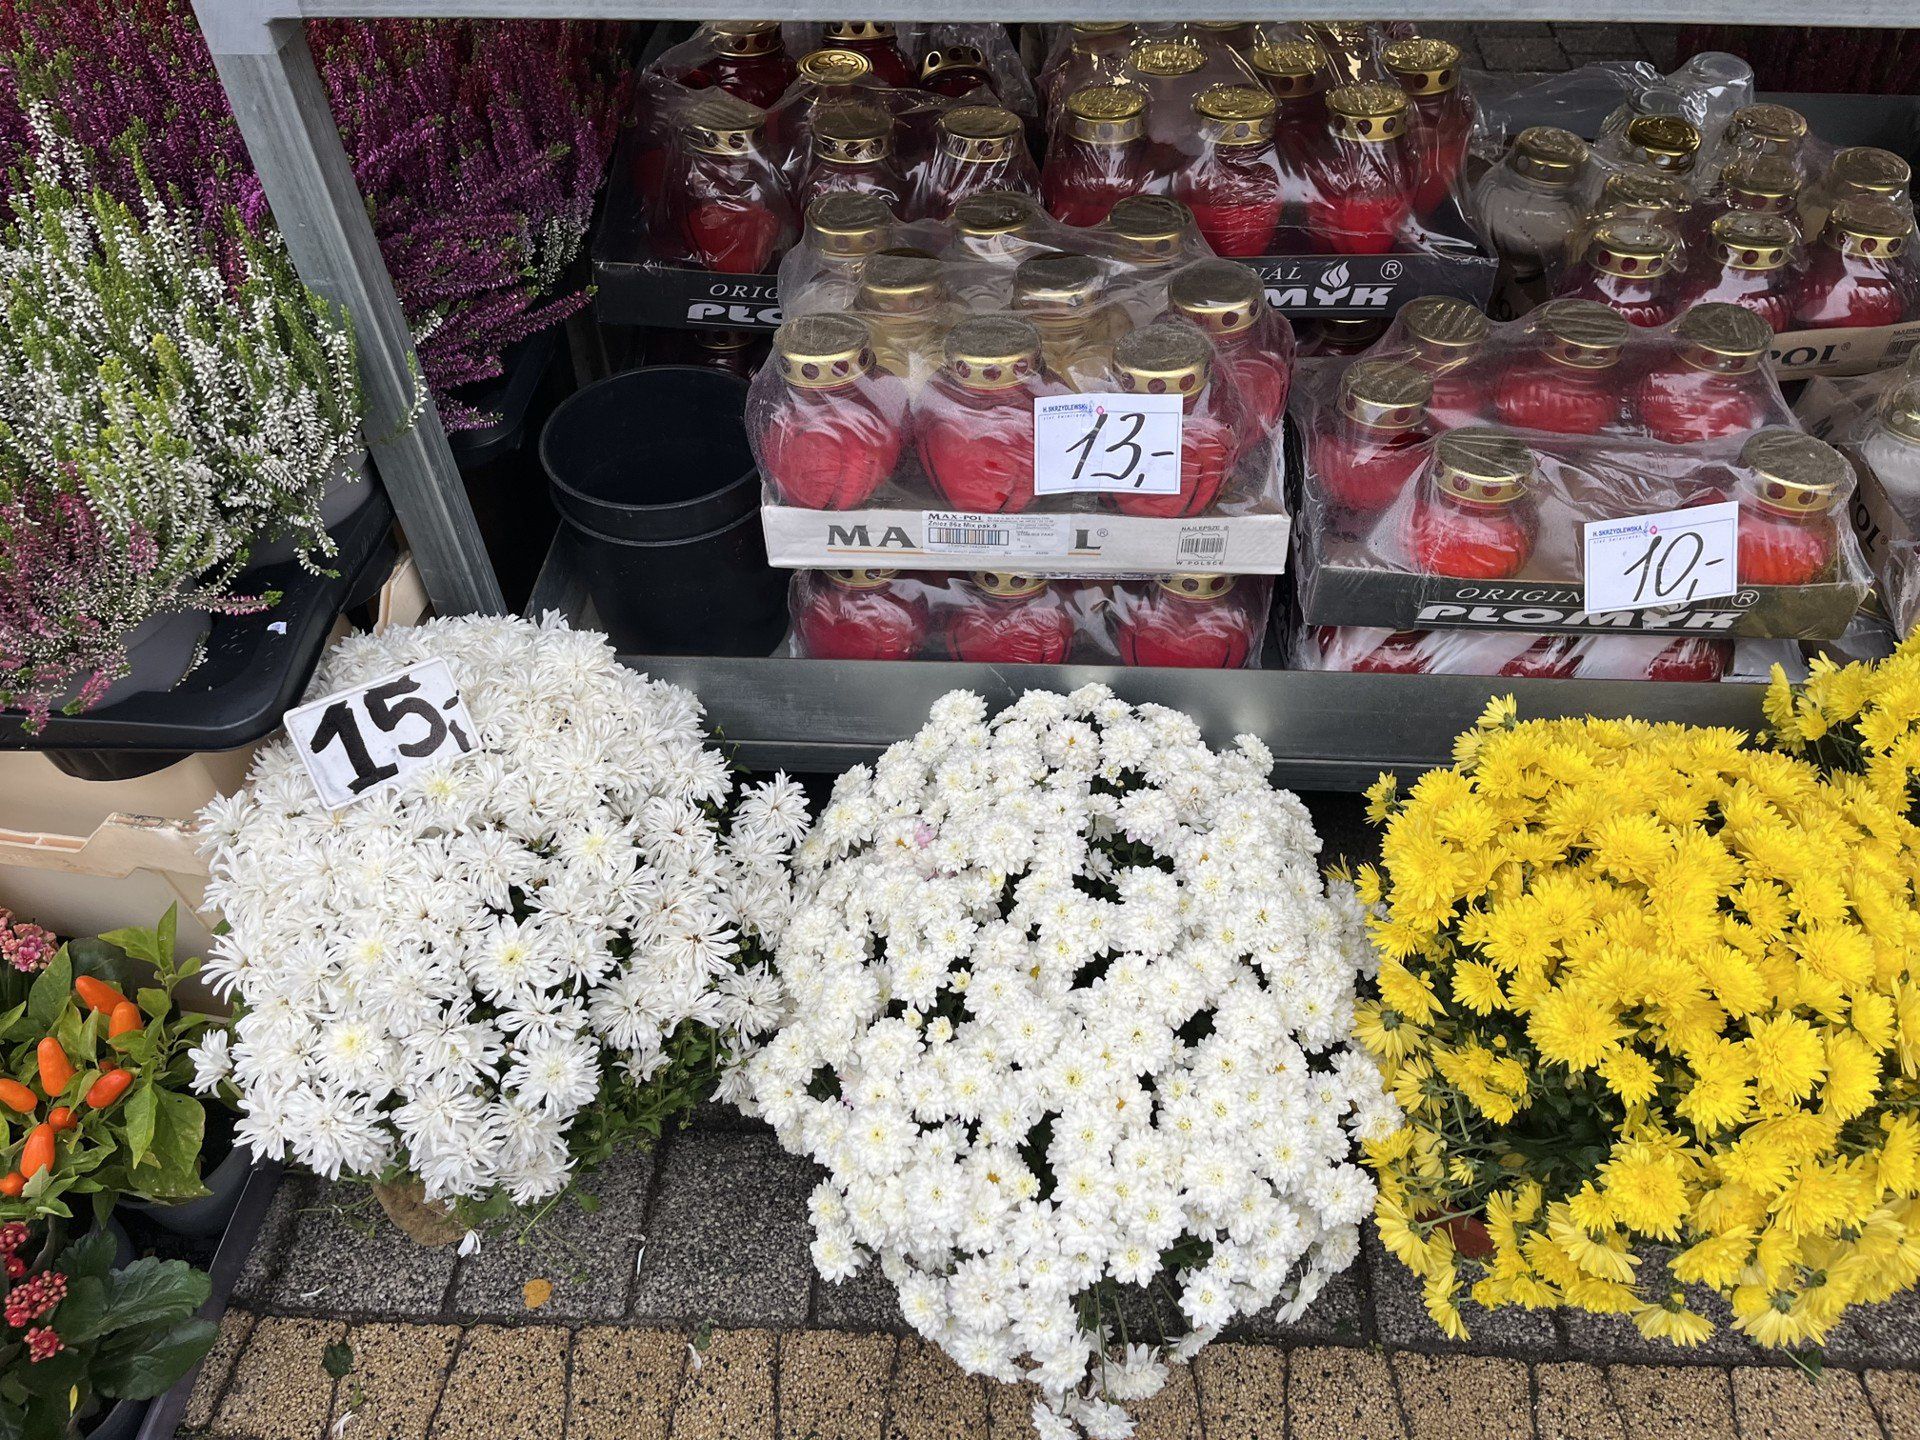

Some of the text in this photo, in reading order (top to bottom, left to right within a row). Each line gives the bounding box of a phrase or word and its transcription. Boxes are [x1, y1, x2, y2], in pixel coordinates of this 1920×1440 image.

[1066, 412, 1174, 488] 13,-
[1623, 531, 1725, 603] 10,-
[1416, 604, 1742, 629] PŁOMYK
